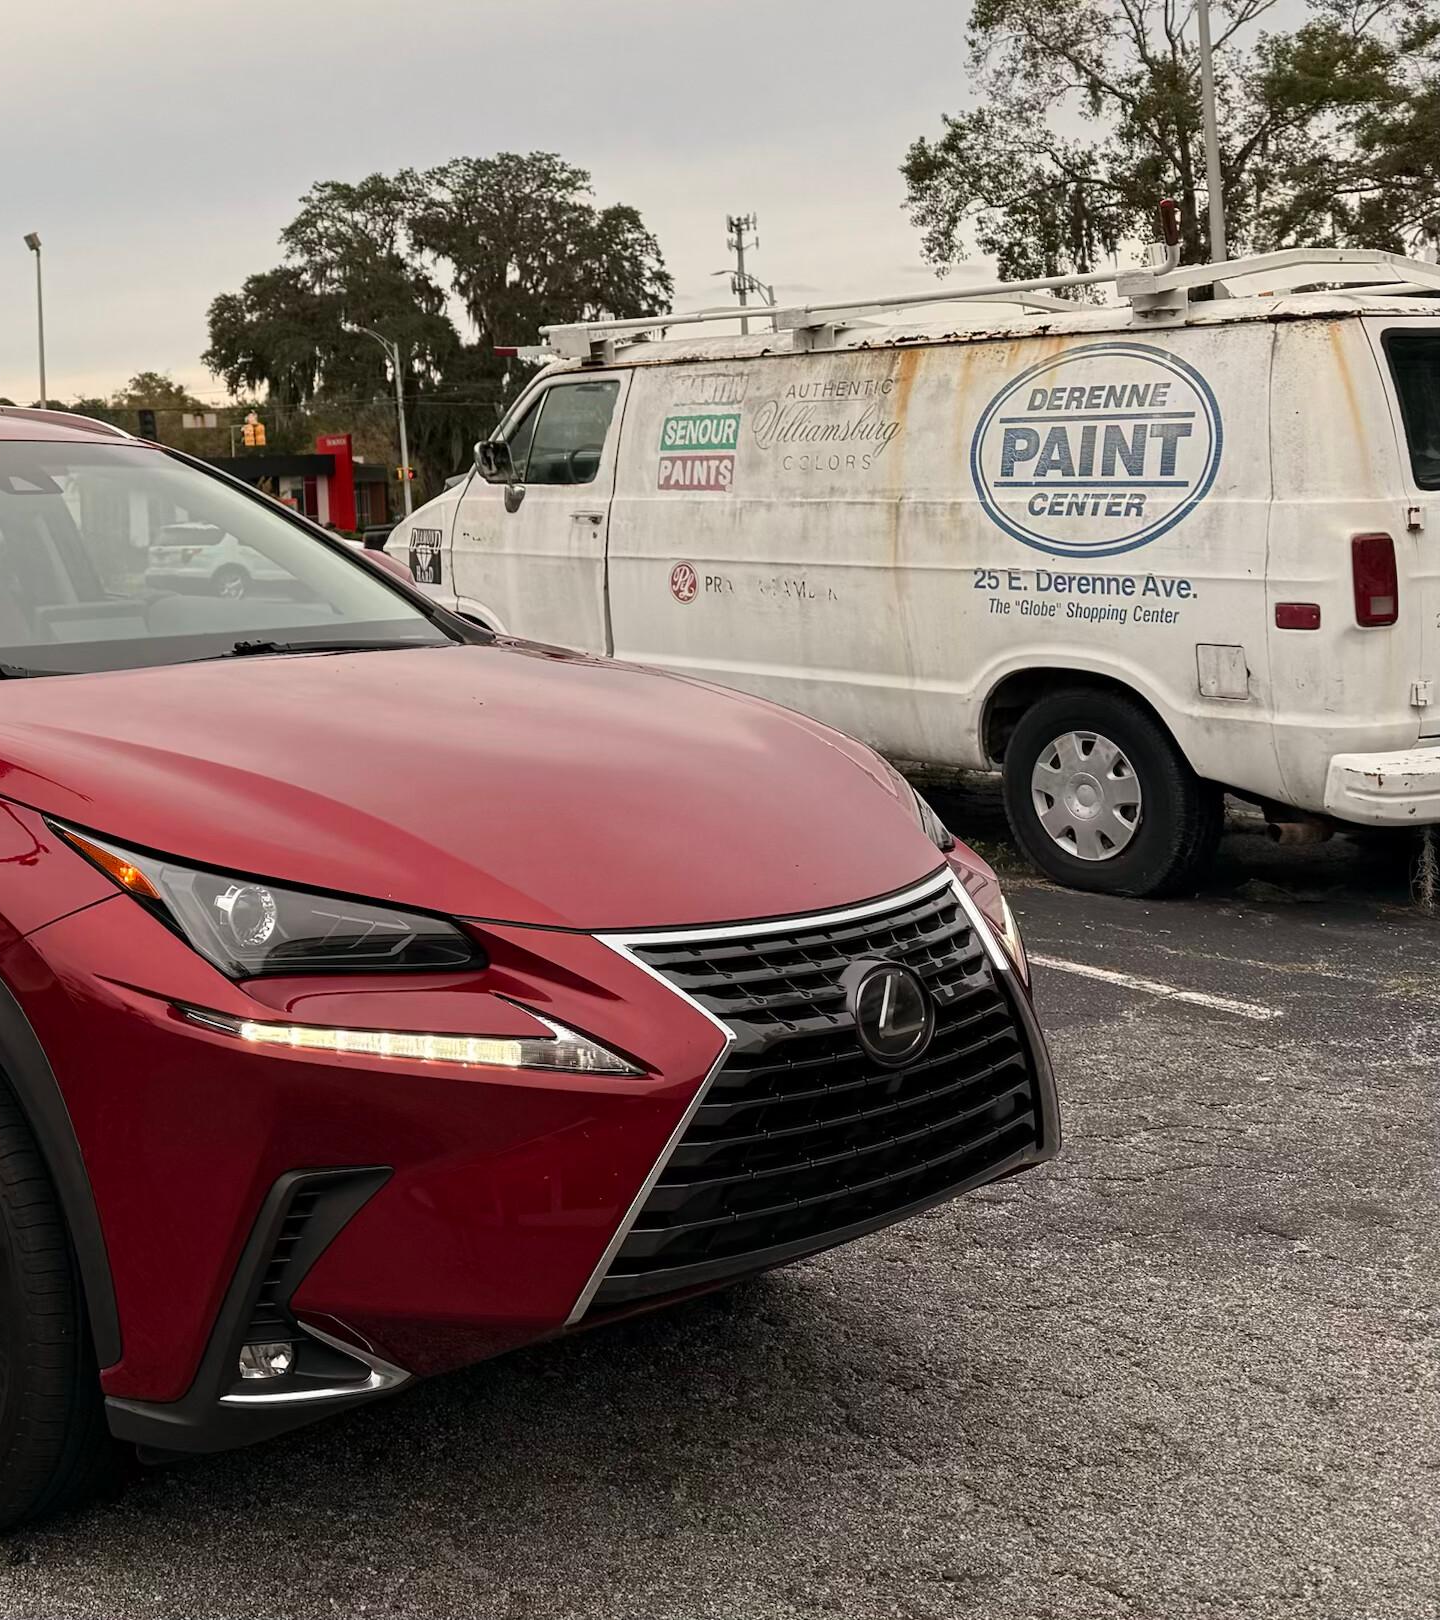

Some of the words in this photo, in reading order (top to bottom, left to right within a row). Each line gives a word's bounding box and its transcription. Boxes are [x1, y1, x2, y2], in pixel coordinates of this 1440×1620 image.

[786, 379, 894, 399] AUTHENTIC
[1027, 382, 1172, 412] DERENNE
[664, 418, 738, 446] SENOUR
[752, 400, 903, 458] Williamsburg
[782, 454, 872, 471] COLORS
[1000, 423, 1193, 477] PAINT
[659, 459, 732, 486] PAINTS
[1028, 493, 1147, 517] CENTER
[973, 569, 1000, 590] 25
[1008, 568, 1028, 591] E.
[1036, 570, 1136, 597] Derenne
[1142, 573, 1198, 599] Ave.
[989, 598, 1010, 614] The
[1015, 600, 1062, 618] "Globe"
[1066, 603, 1127, 625] Shopping
[1133, 606, 1180, 624] Center
